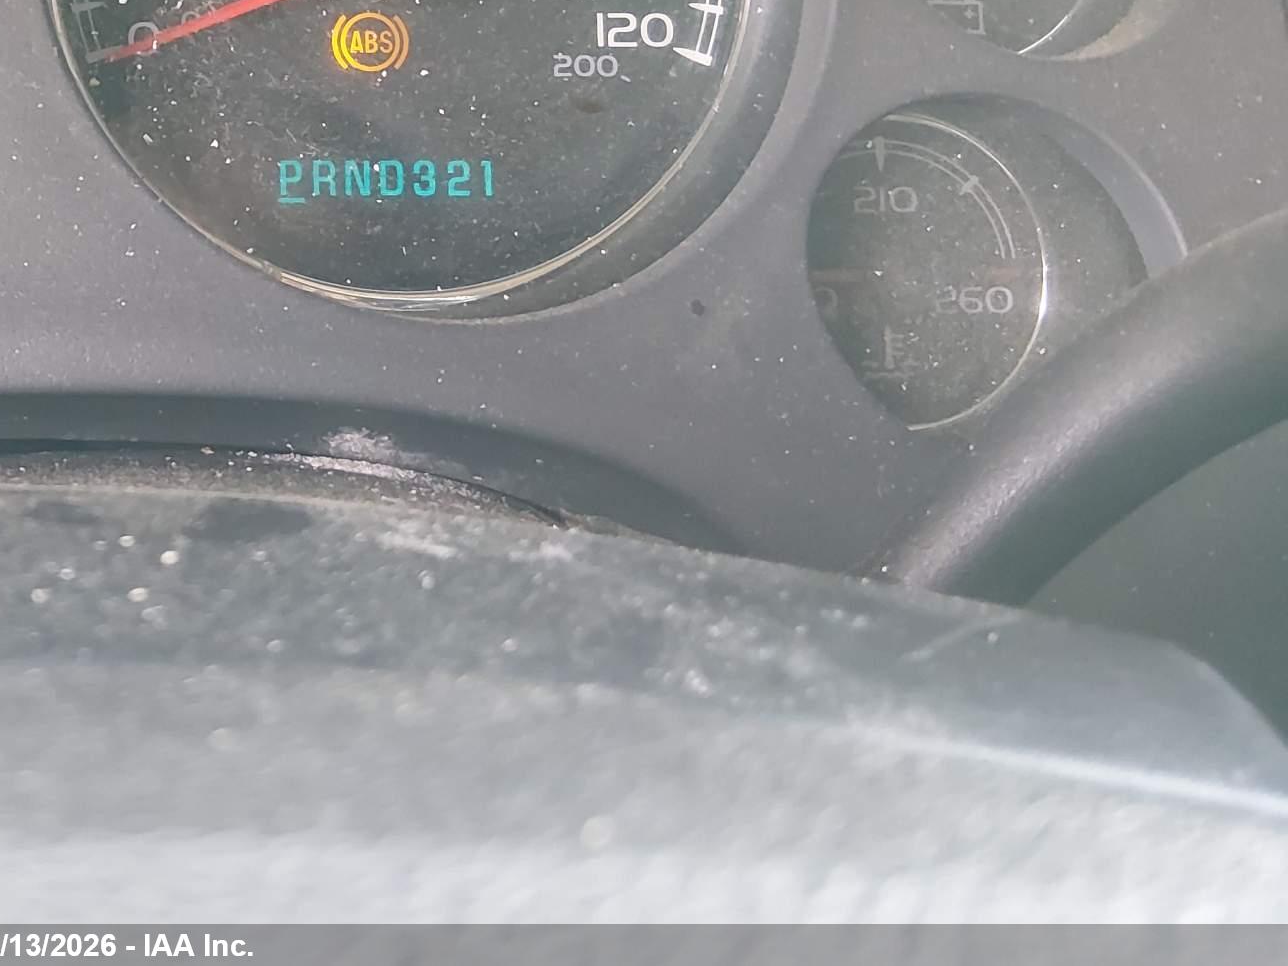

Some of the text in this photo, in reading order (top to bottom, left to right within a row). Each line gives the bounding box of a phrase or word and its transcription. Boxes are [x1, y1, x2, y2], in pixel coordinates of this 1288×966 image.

[350, 30, 393, 55] ABS
[596, 14, 674, 48] 120
[553, 55, 619, 78] 200
[853, 187, 918, 213] 210
[936, 286, 1012, 314] 260
